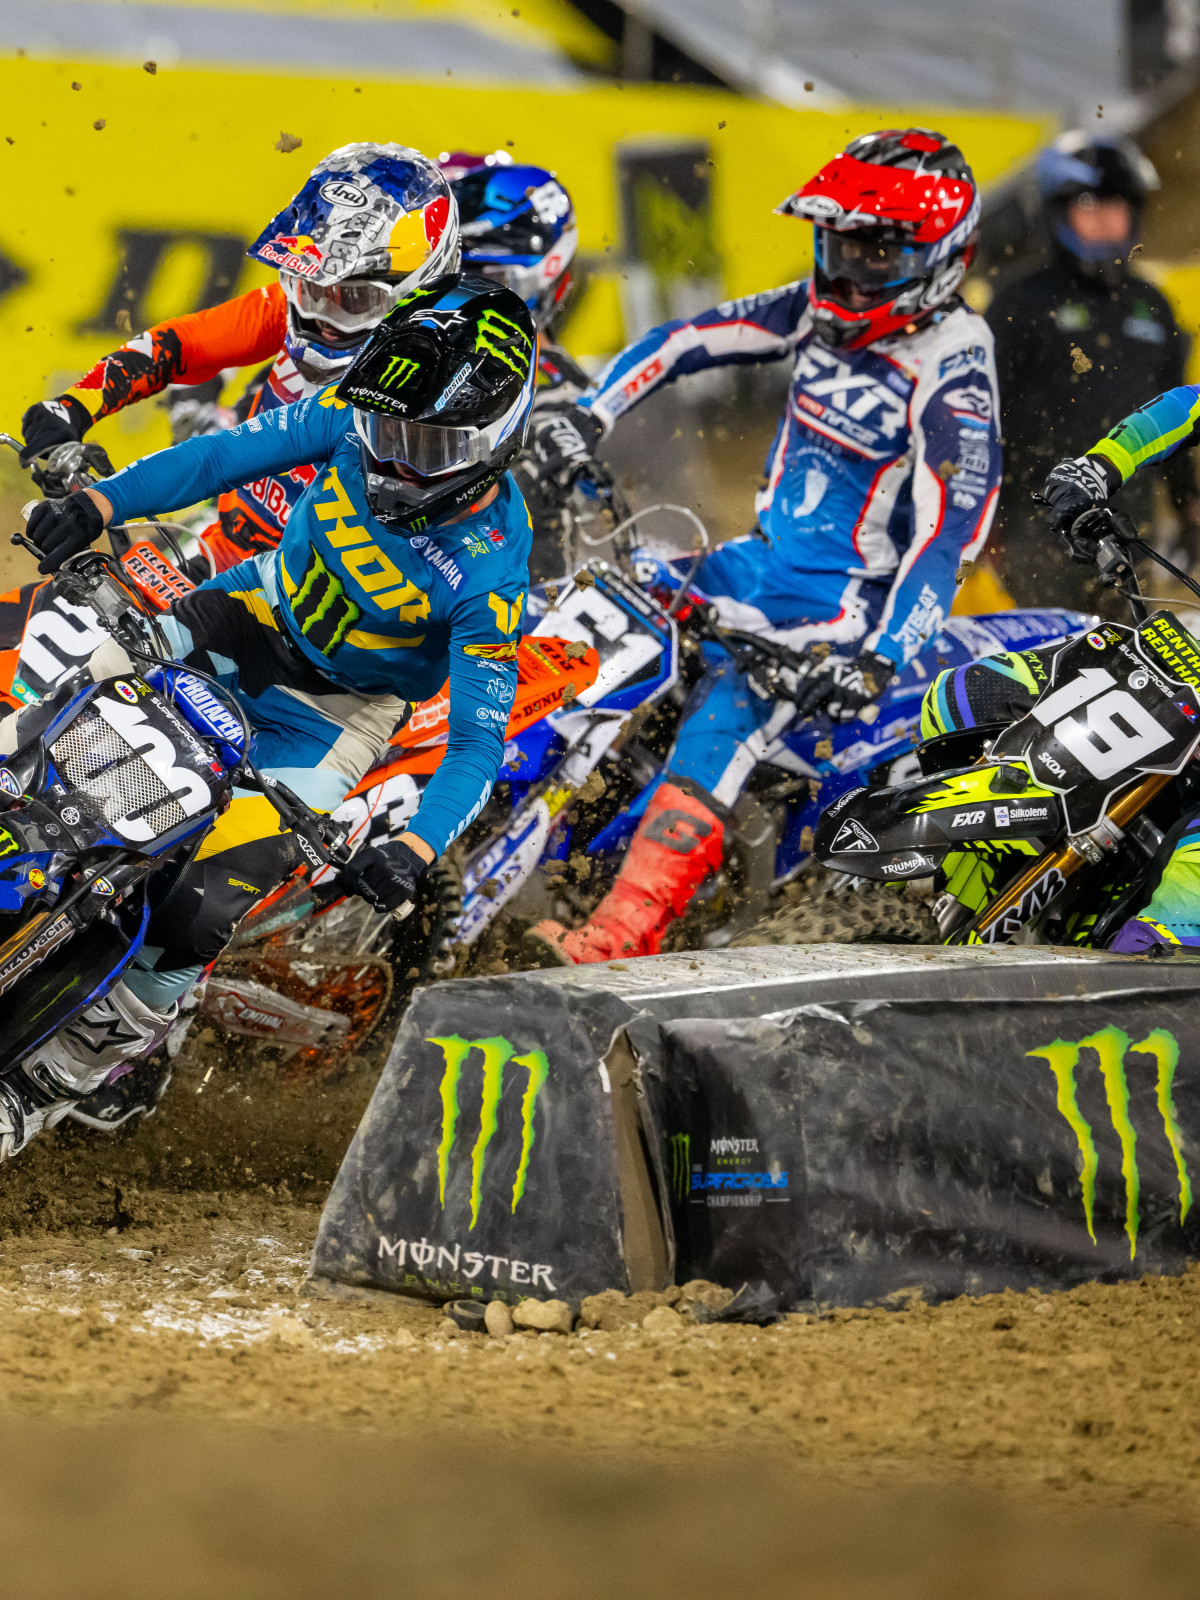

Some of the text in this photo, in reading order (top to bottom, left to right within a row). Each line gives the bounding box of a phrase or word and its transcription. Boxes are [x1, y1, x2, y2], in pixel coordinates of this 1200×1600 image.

[325, 184, 364, 203] Arai
[257, 244, 292, 265] Red
[285, 251, 321, 276] Bull
[347, 386, 410, 414] MONSTER
[793, 343, 908, 440] FXR
[126, 556, 181, 605] RENTH
[137, 546, 192, 594] RENTH
[421, 542, 465, 592] YAMAHA
[176, 672, 246, 745] PROTAPER
[522, 687, 566, 717] DUNL
[1037, 751, 1068, 780] SKDA
[950, 810, 987, 828] FXR
[1009, 807, 1048, 819] Silkolene
[850, 821, 873, 845] TRIUMPH
[295, 833, 324, 866] ARC
[881, 856, 927, 875] TRIUMPH
[227, 876, 261, 895] SPORT
[711, 1136, 759, 1156] MONSTER
[717, 1157, 752, 1166] ENERGY
[377, 1235, 557, 1292] MONSTER
